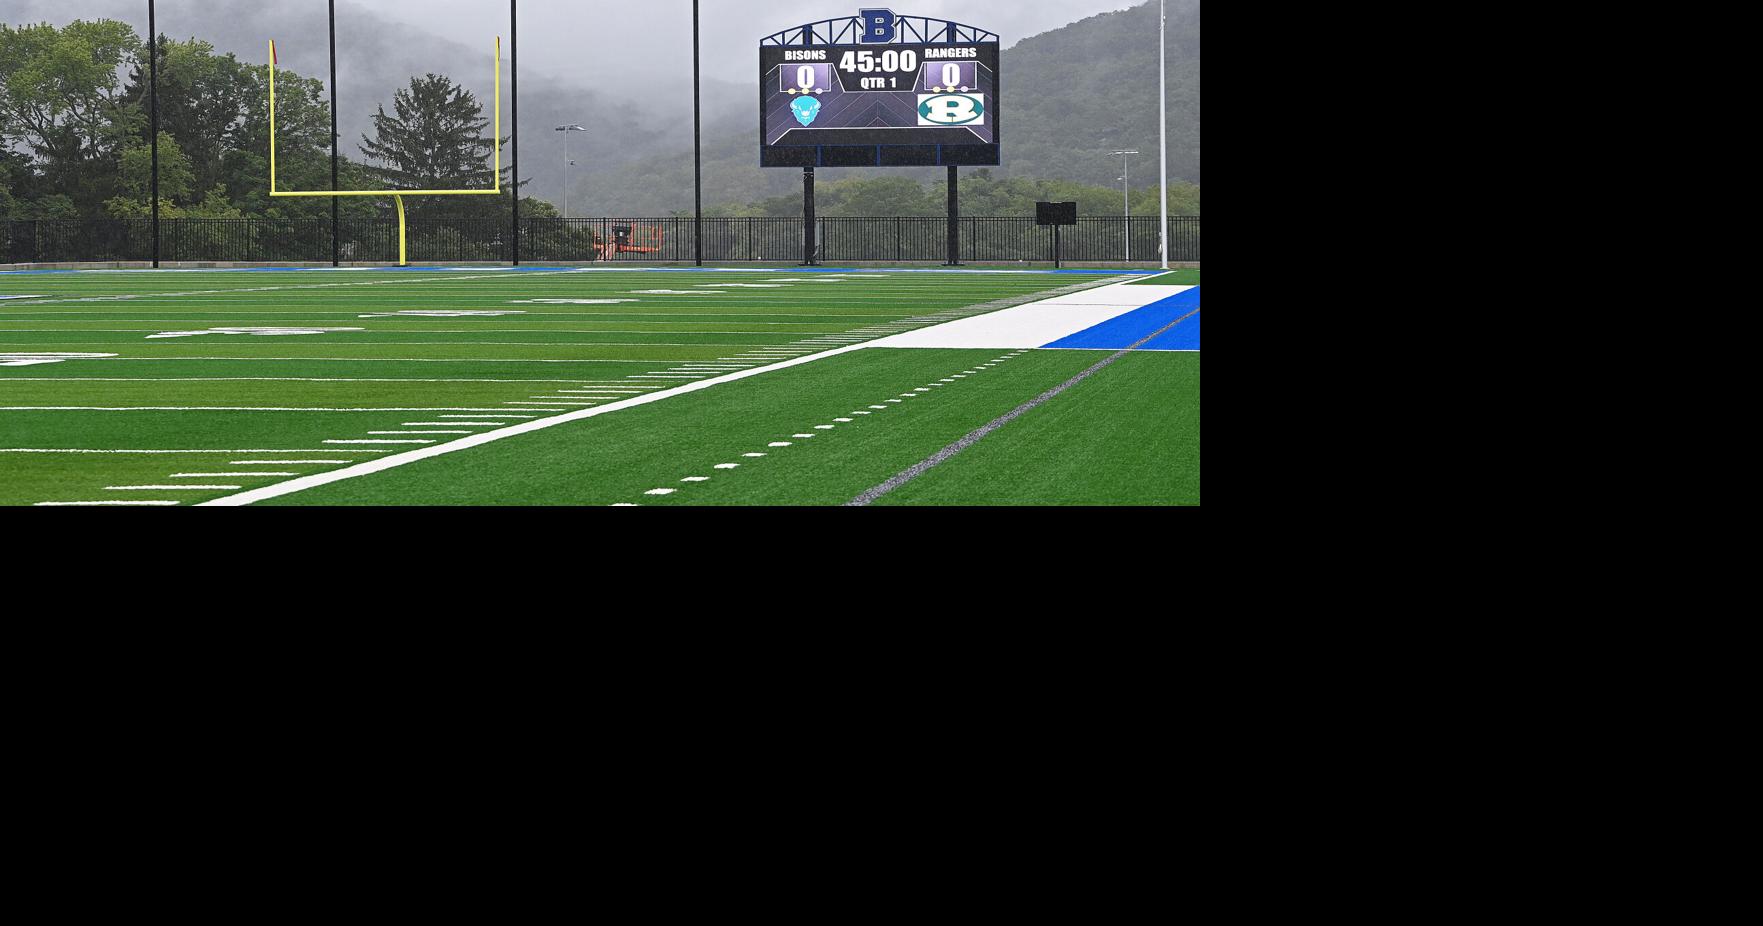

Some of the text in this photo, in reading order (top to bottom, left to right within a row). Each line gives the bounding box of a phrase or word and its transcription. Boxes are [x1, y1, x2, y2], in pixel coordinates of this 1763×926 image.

[859, 8, 896, 44] B
[785, 50, 827, 61] BISONS
[839, 50, 917, 73] 45:00
[925, 47, 977, 59] RANGERS
[797, 66, 815, 88] 0
[860, 77, 897, 89] QTR 1
[942, 63, 961, 87] 0
